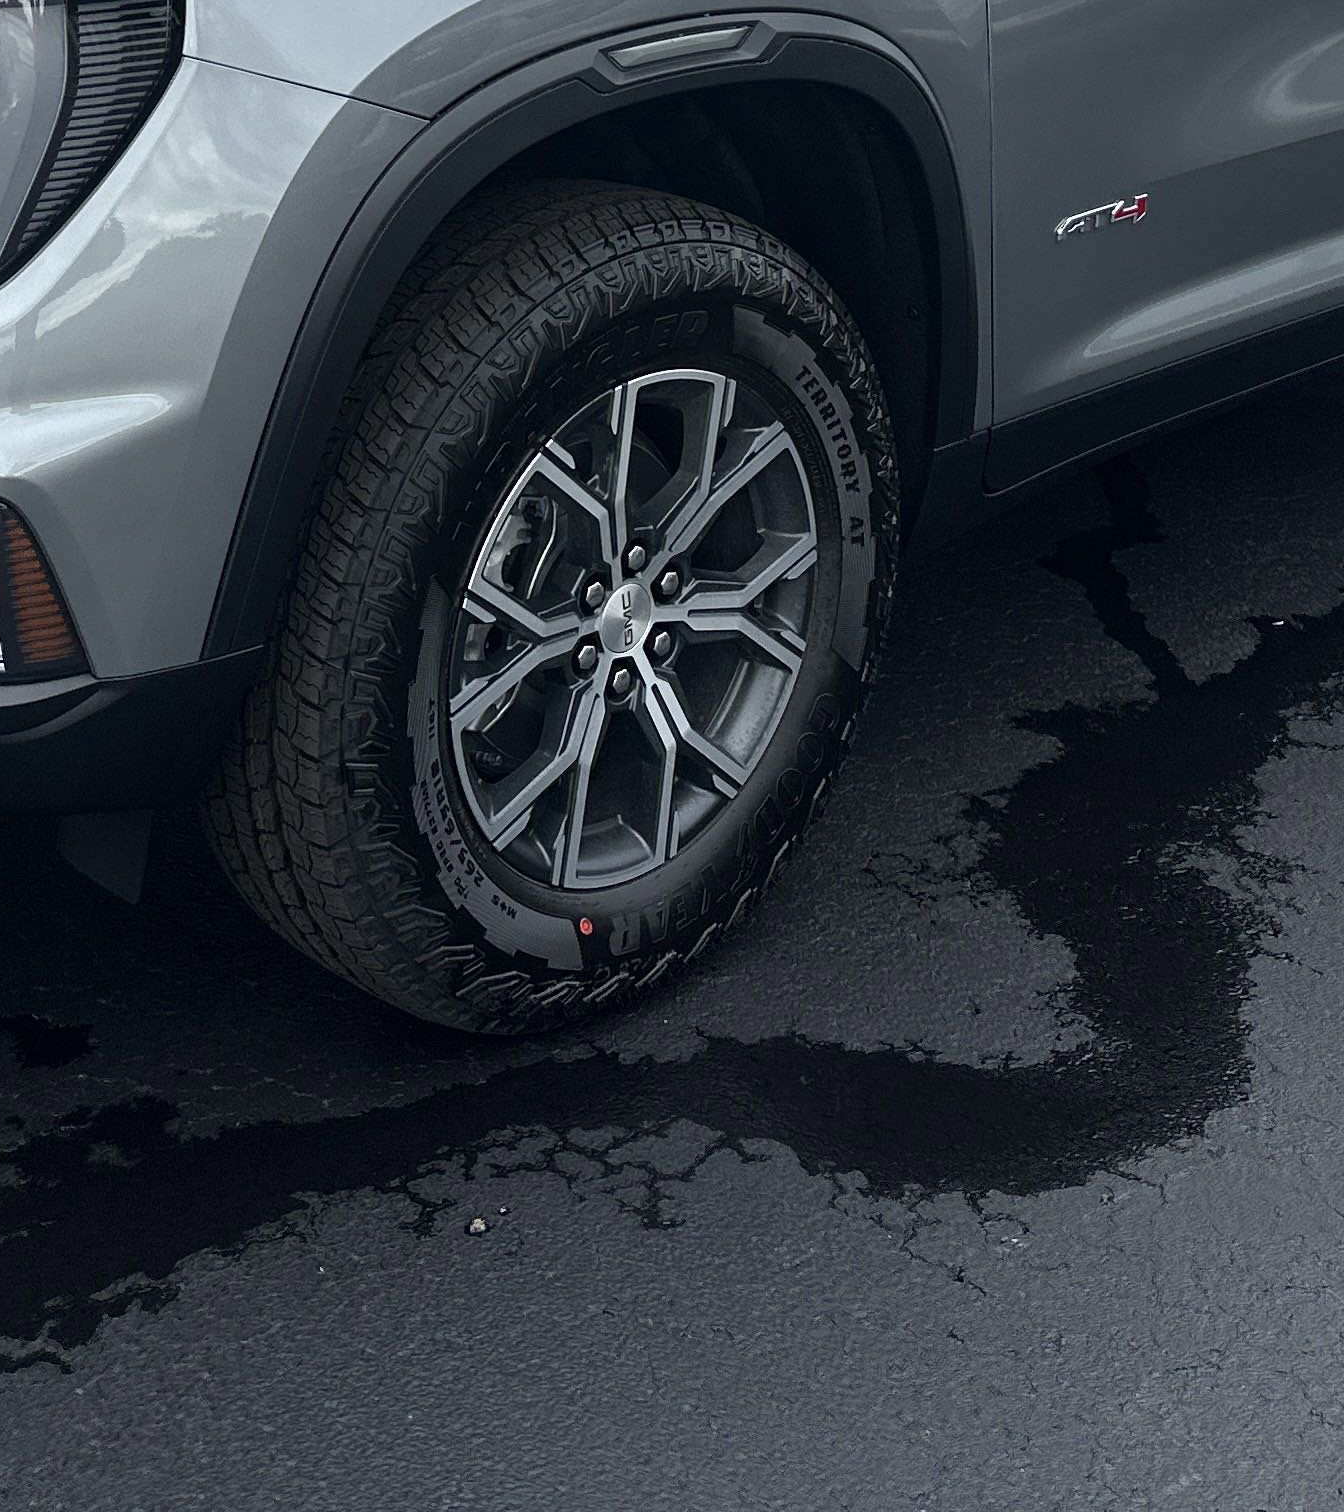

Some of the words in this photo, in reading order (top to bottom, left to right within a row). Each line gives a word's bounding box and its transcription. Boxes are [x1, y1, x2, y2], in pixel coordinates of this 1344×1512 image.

[1054, 193, 1148, 241] AT4
[795, 365, 860, 495] TERRITORY
[849, 515, 865, 547] AT
[622, 590, 634, 646] GMC
[431, 757, 485, 889] 265/65R18
[490, 893, 518, 920] M+S
